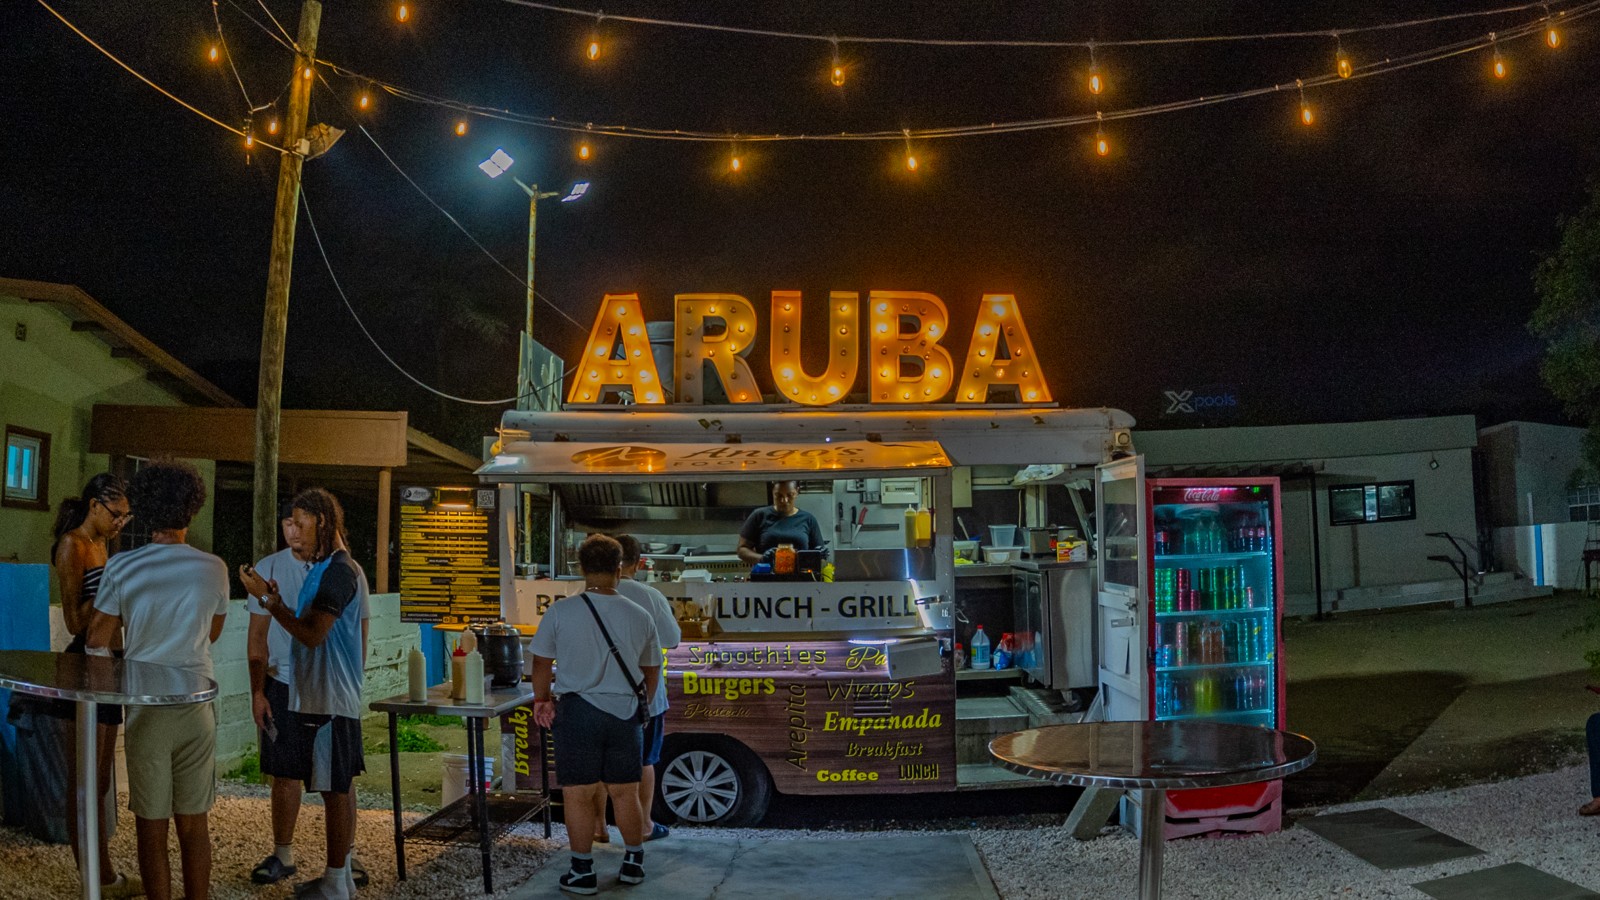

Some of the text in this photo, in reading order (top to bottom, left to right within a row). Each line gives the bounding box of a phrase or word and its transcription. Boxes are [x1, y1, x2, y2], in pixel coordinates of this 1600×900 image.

[566, 290, 1054, 406] ARUBA
[673, 459, 758, 467] FOOD
[679, 445, 865, 461] Ango's
[717, 597, 813, 619] LUNCH
[838, 595, 916, 618] GRILL
[688, 643, 827, 665] Smoothies
[683, 671, 776, 700] Burgers
[826, 679, 915, 707] Wraps
[822, 708, 943, 736] Empanada
[514, 706, 533, 777] Break
[845, 741, 924, 760] Breakfast
[816, 763, 940, 782] Coffee LUNCH
